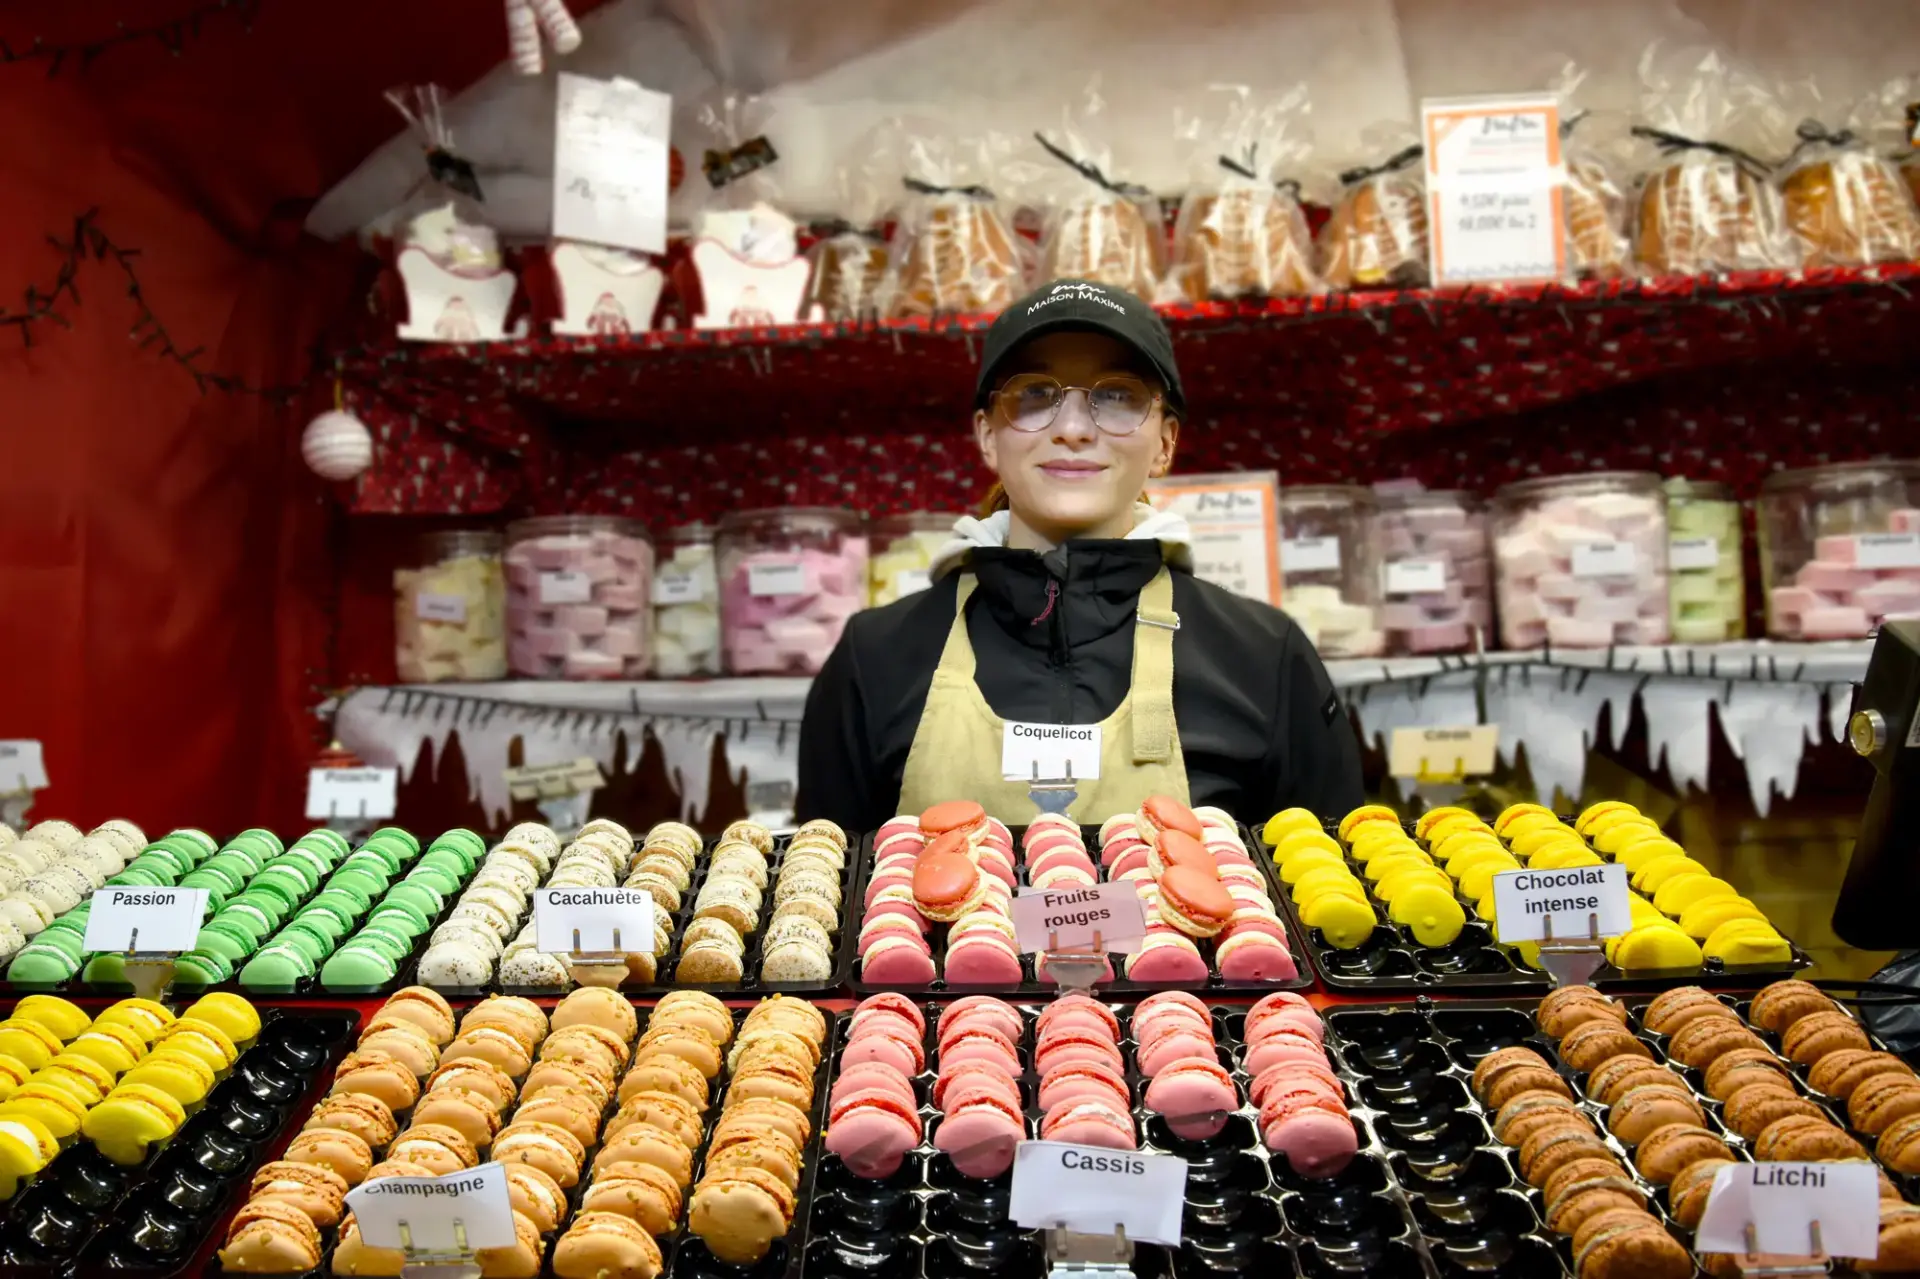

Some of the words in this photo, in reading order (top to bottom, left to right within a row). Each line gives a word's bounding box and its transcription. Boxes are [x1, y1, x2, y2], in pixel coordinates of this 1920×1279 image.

[1012, 724, 1093, 741] Coquelicot
[1514, 868, 1605, 891] Chocolat
[112, 890, 176, 906] Passion
[548, 889, 642, 906] Cacahuète
[1043, 889, 1101, 908] Fruits
[1525, 895, 1599, 914] intense
[1044, 908, 1111, 928] rouges
[1061, 1150, 1145, 1176] Cassis
[1752, 1165, 1826, 1188] Litchi
